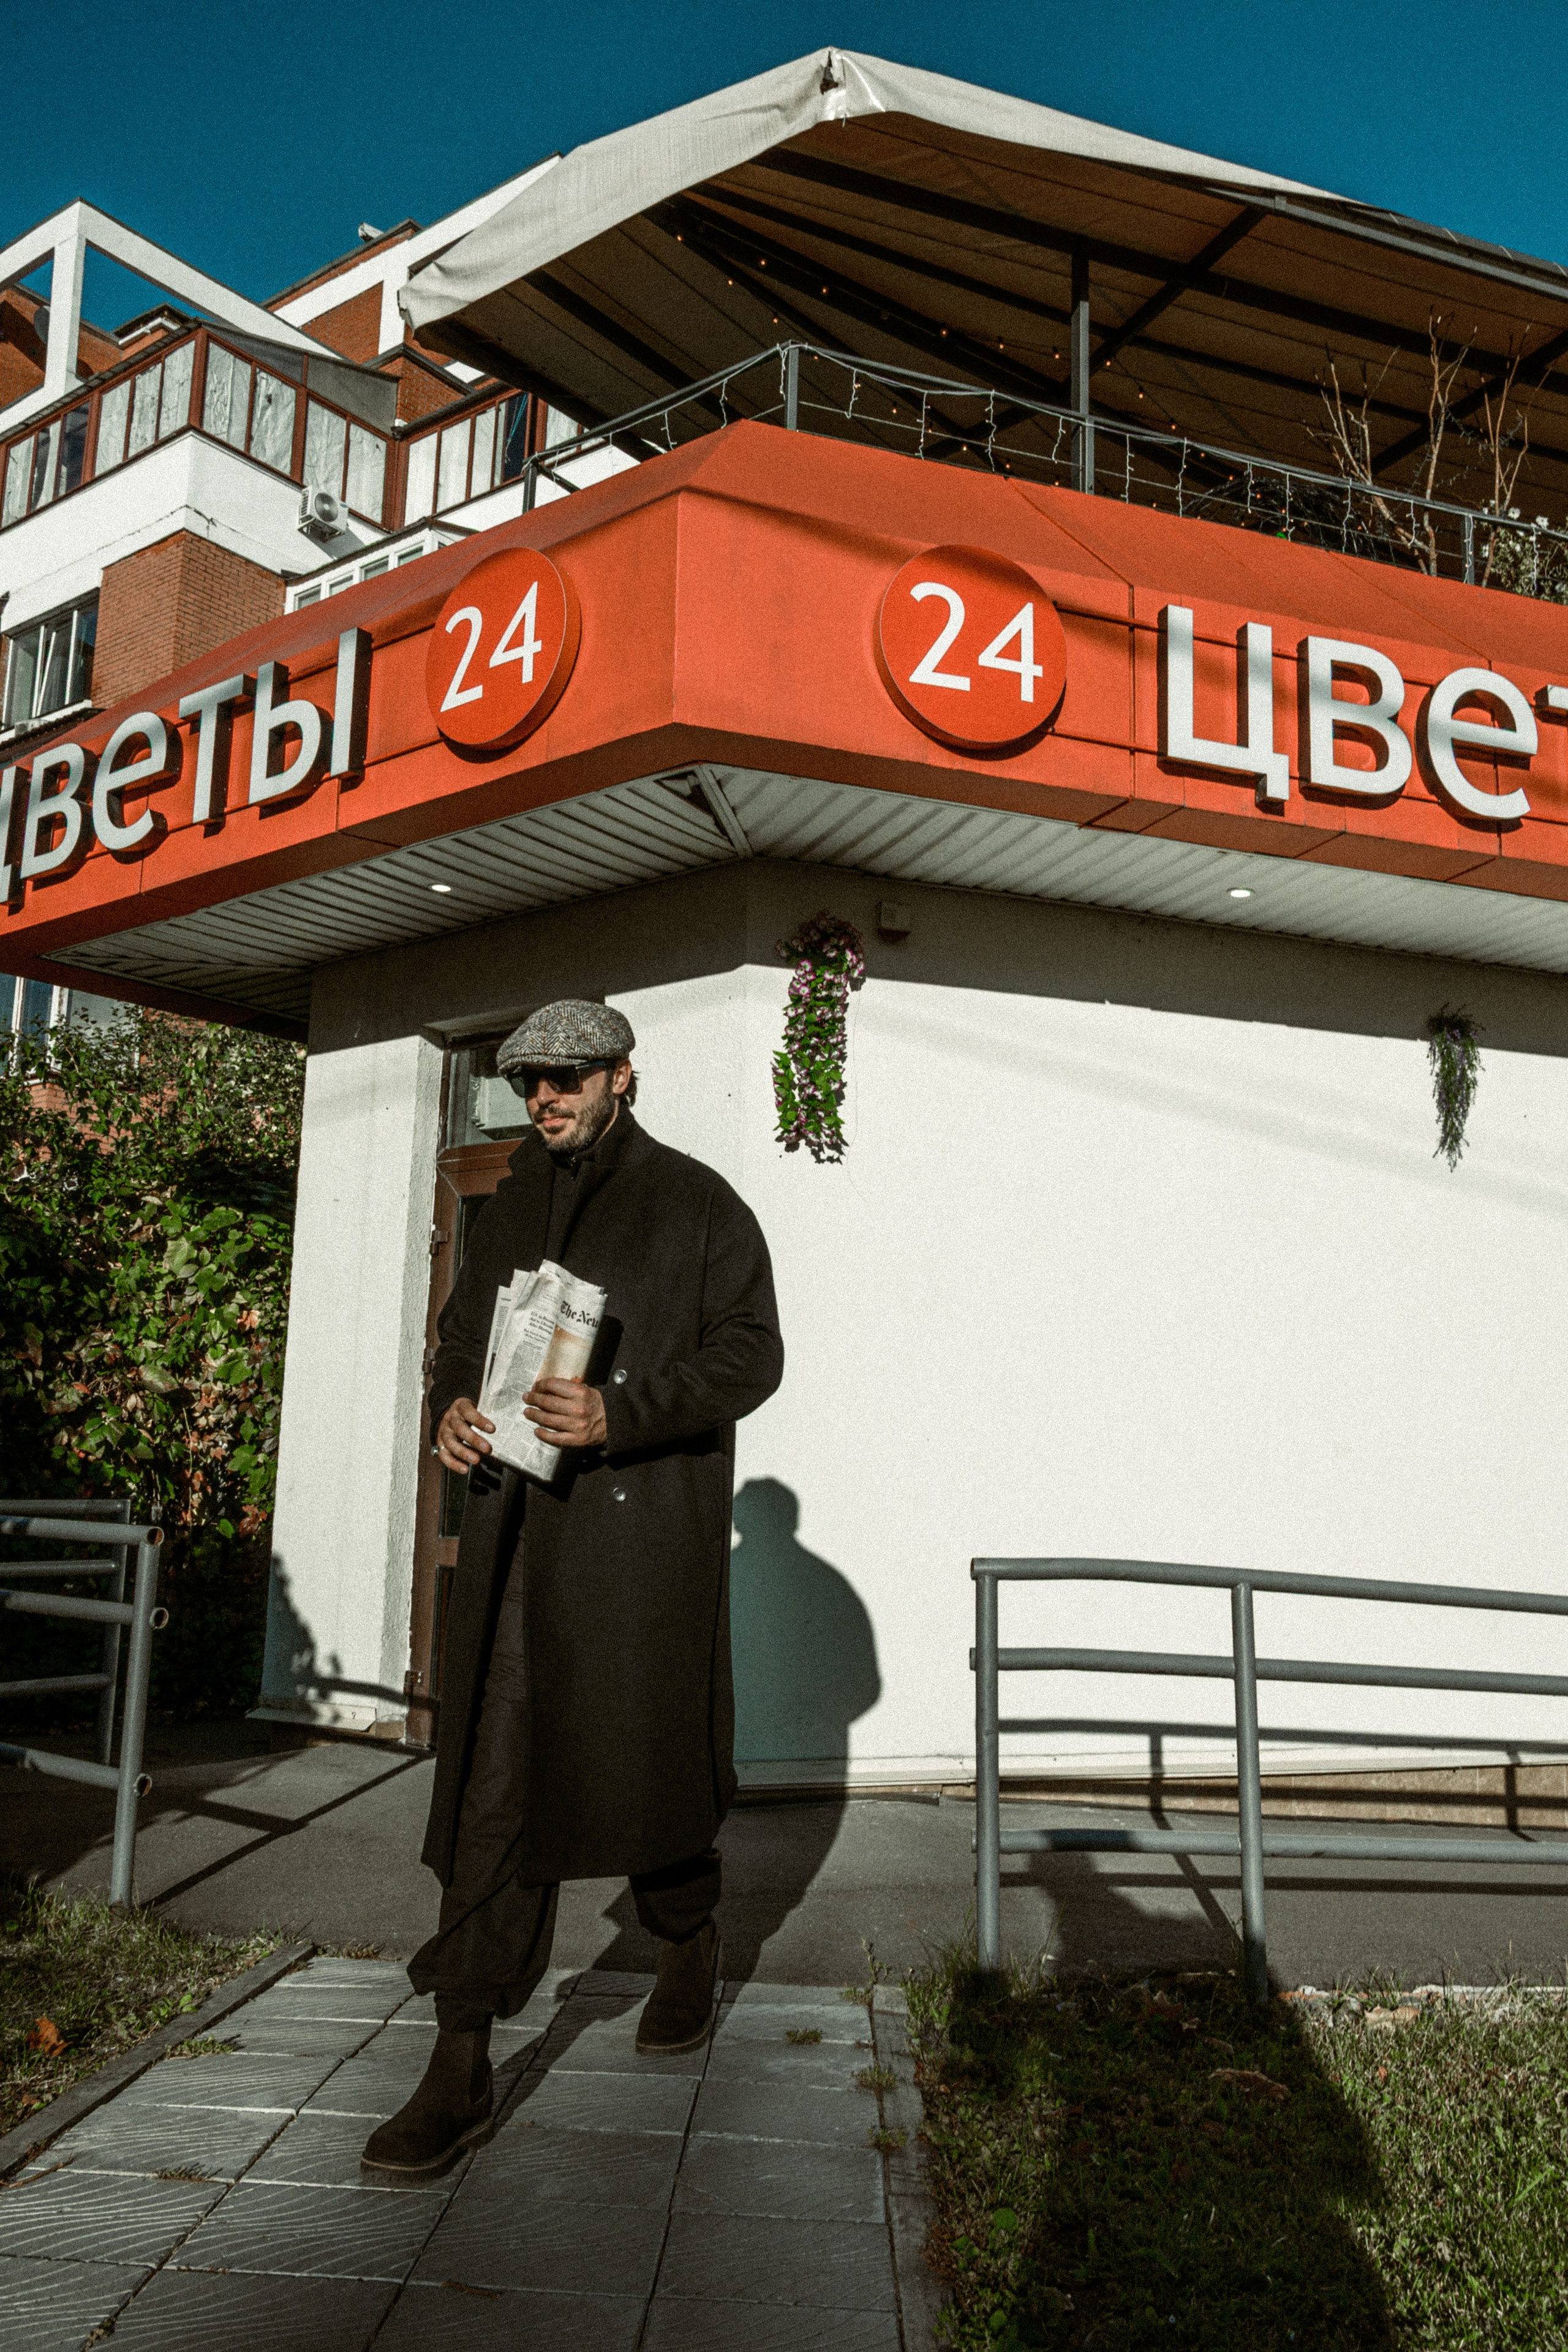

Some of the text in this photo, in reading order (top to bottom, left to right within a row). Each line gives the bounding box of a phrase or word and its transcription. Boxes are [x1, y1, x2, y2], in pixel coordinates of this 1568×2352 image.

[440, 581, 542, 713] 24
[909, 581, 1043, 703] 24
[560, 1300, 577, 1319] The
